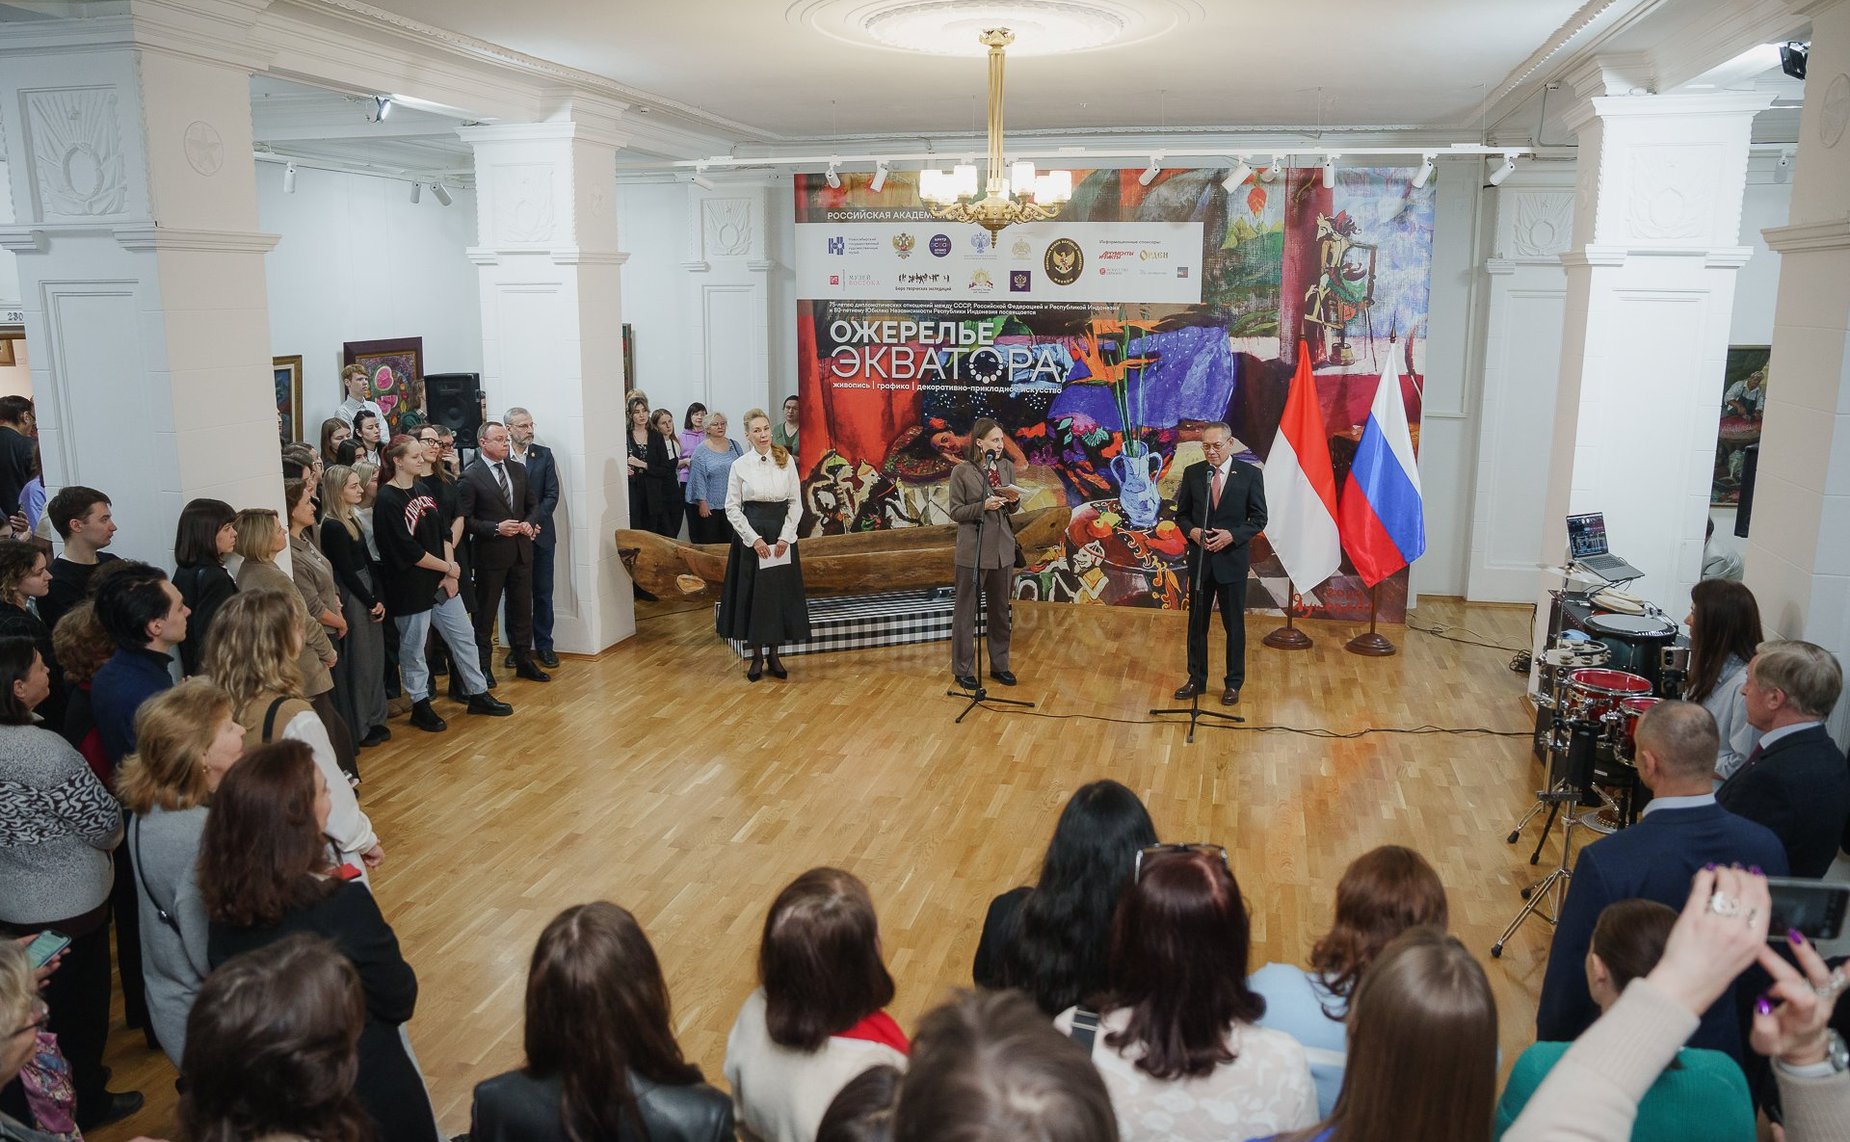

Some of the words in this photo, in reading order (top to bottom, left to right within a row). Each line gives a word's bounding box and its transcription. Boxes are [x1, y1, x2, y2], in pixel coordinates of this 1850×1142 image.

[827, 209, 891, 219] РОССИЙСКАЯ
[893, 210, 945, 219] АКАДЕМ
[830, 320, 994, 345] ОЖЕРЕЛЬЕ
[831, 345, 1062, 384] ЭКВАТОРА
[833, 382, 870, 390] живопись
[877, 381, 910, 391] графика
